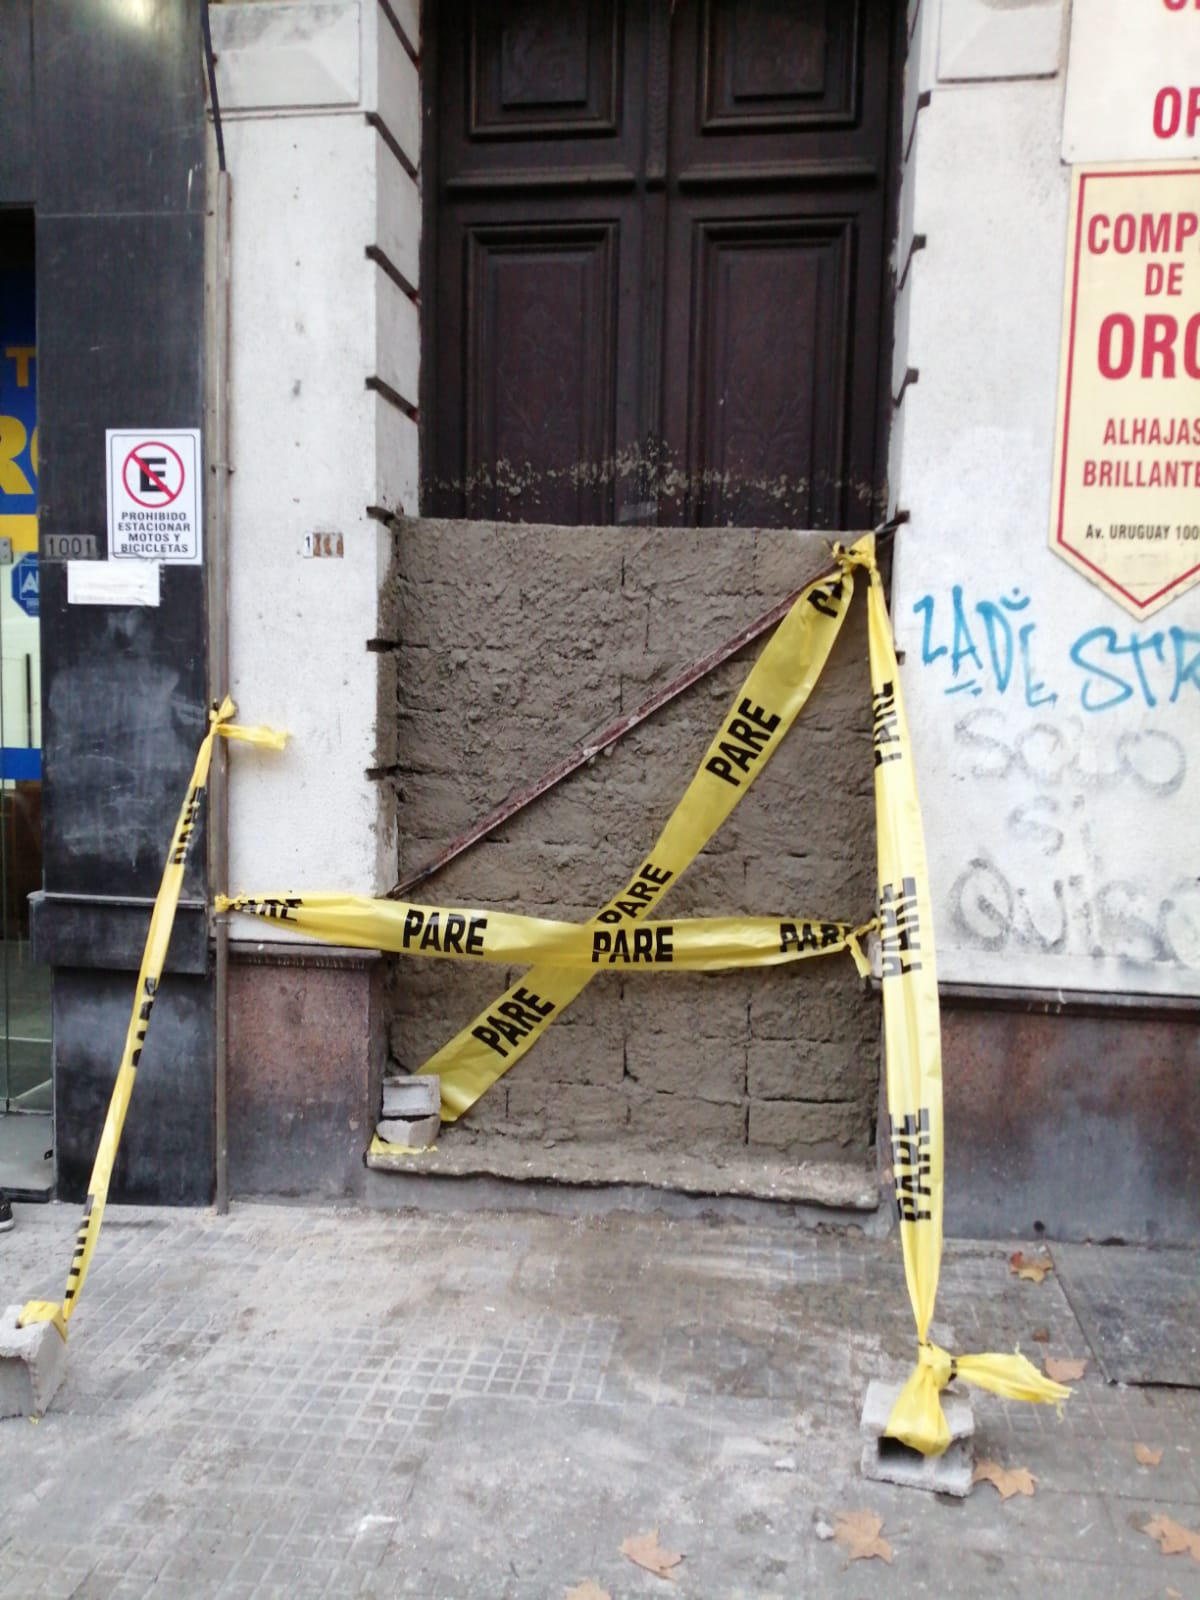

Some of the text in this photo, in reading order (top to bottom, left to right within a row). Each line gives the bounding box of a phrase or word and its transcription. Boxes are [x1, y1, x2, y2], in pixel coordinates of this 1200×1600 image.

[1087, 212, 1200, 254] COMP
[1144, 263, 1184, 296] DE
[118, 522, 191, 532] ESTACIONAR
[121, 512, 187, 521] PROHIBIDO
[1109, 525, 1170, 540] URUGUAY
[48, 535, 92, 556] 1001
[121, 543, 189, 553] BICICLETAS
[128, 533, 181, 542] MOTOS Y
[705, 698, 782, 787] PARE
[597, 864, 674, 924] PARE
[403, 909, 488, 956] PARE
[592, 927, 674, 963] PARE
[471, 987, 555, 1057] PARE
